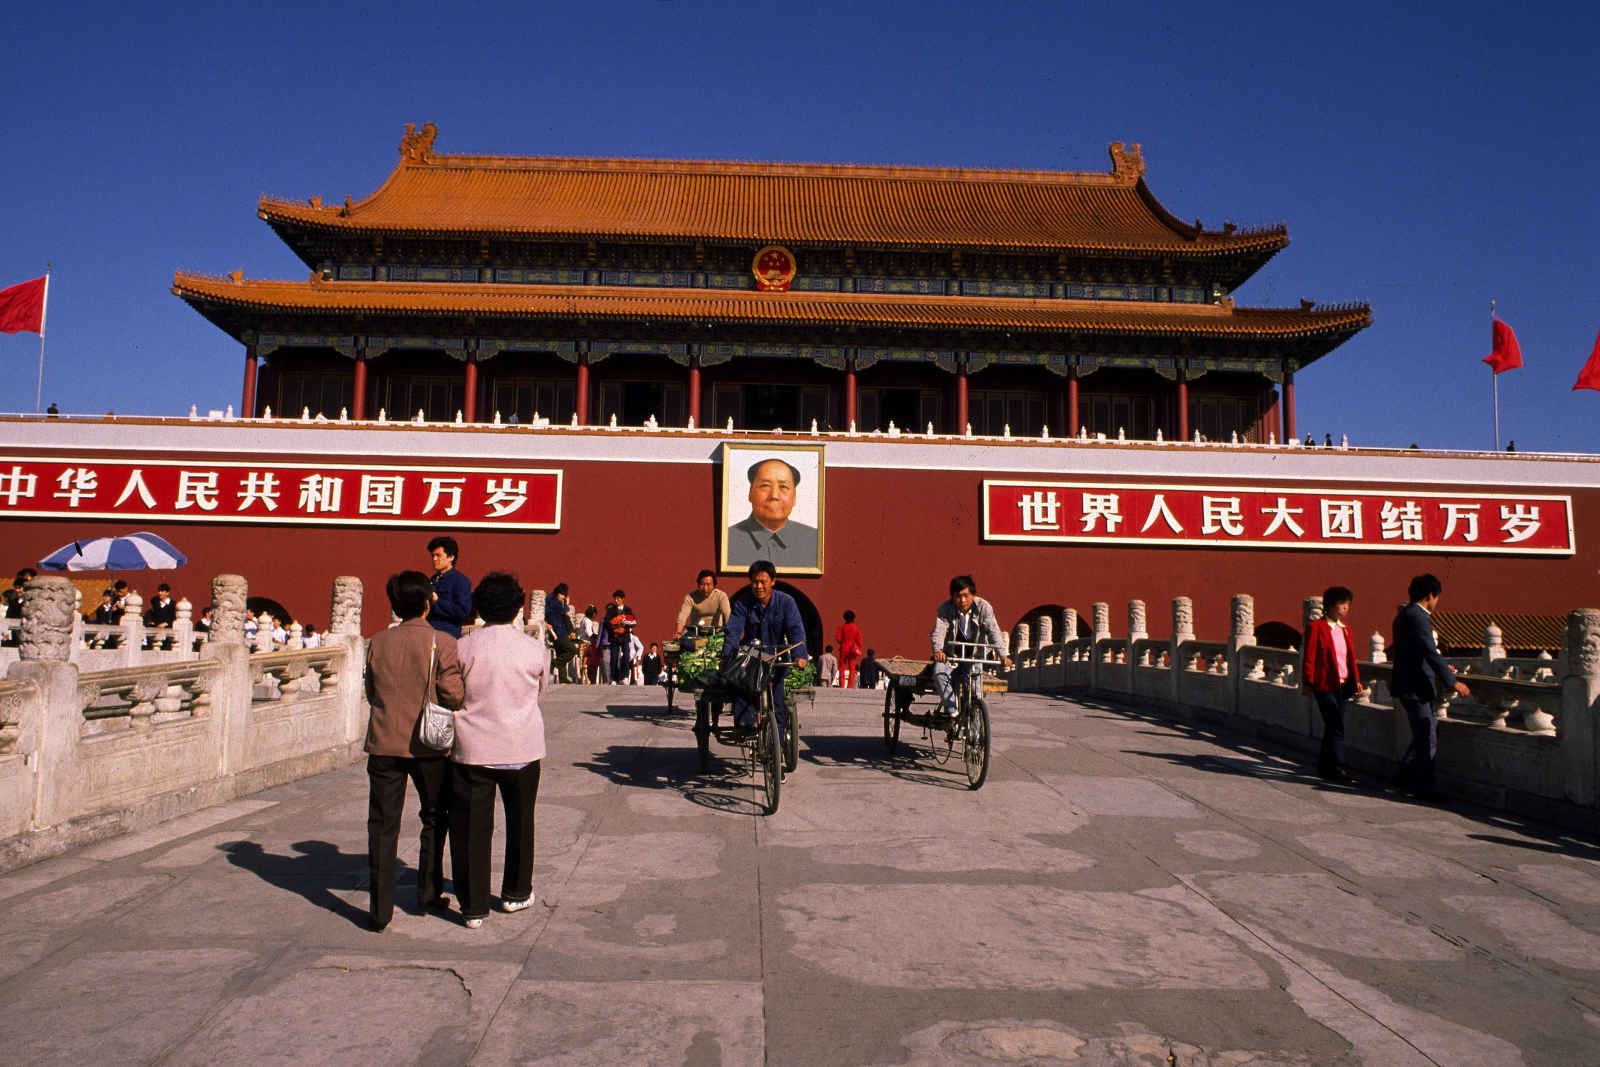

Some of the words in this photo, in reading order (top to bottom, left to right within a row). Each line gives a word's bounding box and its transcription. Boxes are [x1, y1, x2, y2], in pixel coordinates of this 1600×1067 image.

[0, 466, 528, 518] 中华人民共和国万岁
[1017, 491, 1542, 543] 世界人民大团结万岁
